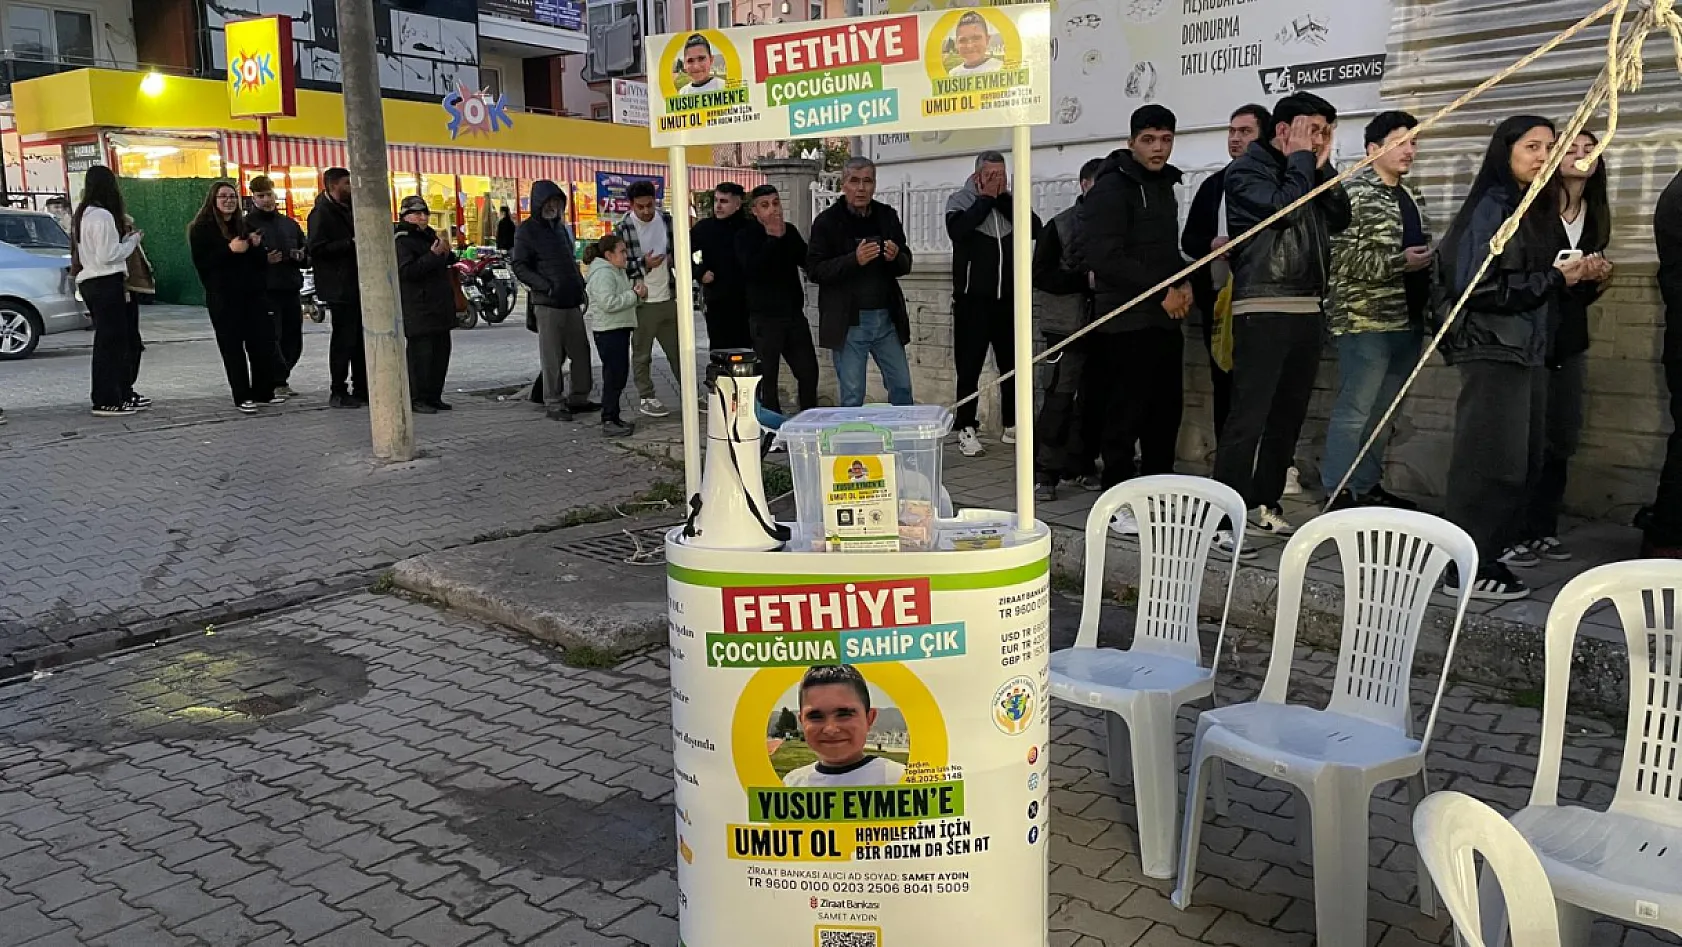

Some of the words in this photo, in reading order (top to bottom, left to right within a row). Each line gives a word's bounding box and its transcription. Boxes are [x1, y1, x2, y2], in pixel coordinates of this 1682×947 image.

[1182, 15, 1239, 45] DONDURMA
[765, 25, 904, 74] FETHİYE
[1181, 51, 1207, 76] TATLI
[1211, 39, 1262, 76] ÇEŞİTLERİ
[937, 76, 974, 95] YUSUF
[975, 71, 1024, 90] EYMEN'E
[1297, 68, 1335, 84] PAKET
[1338, 58, 1382, 79] SERVİS
[669, 94, 700, 111] YUSUF
[702, 89, 745, 107] EYMEN'E
[771, 71, 873, 106] ÇOCUĞUNA
[793, 98, 853, 128] SAHİP
[858, 97, 892, 125] ÇIK
[926, 97, 958, 114] UMUT
[960, 96, 975, 110] OL
[661, 114, 687, 131] UMUT
[690, 113, 702, 127] OL
[734, 584, 919, 632] FETHİYE
[999, 609, 1012, 618] TR
[712, 637, 837, 668] ÇOCUĞUNA
[846, 631, 914, 657] SAHİP
[920, 630, 959, 658] ÇIK
[1001, 631, 1019, 643] USD
[1001, 643, 1019, 654] EUR
[1001, 656, 1020, 666] GBP
[758, 790, 836, 820] YUSUF
[843, 786, 954, 818] EYMEN’E
[735, 827, 803, 858] UMUT
[810, 829, 841, 858] OL
[856, 821, 936, 843] HAYALLERİM
[939, 818, 971, 842] İÇİN
[856, 841, 880, 860] BİR
[885, 843, 921, 859] ADIM
[925, 841, 942, 857] DA
[975, 836, 991, 853] AT
[747, 866, 778, 877] ZİRAAT
[780, 869, 820, 879] BANKASI
[822, 870, 846, 880] ALICI
[847, 872, 862, 881] AD
[901, 872, 936, 882] SAMET
[937, 871, 969, 881] AYDIN
[747, 877, 762, 888] TR
[765, 878, 797, 890] 9600
[800, 880, 829, 892] 0100
[833, 881, 864, 893] 0203
[868, 882, 900, 894] 2506
[903, 882, 933, 894] 8041
[936, 881, 969, 893] 5009
[820, 898, 845, 908] Ziraat
[847, 899, 880, 909] Bankası
[817, 912, 848, 921] SAMET
[850, 913, 878, 922] AYDIN
